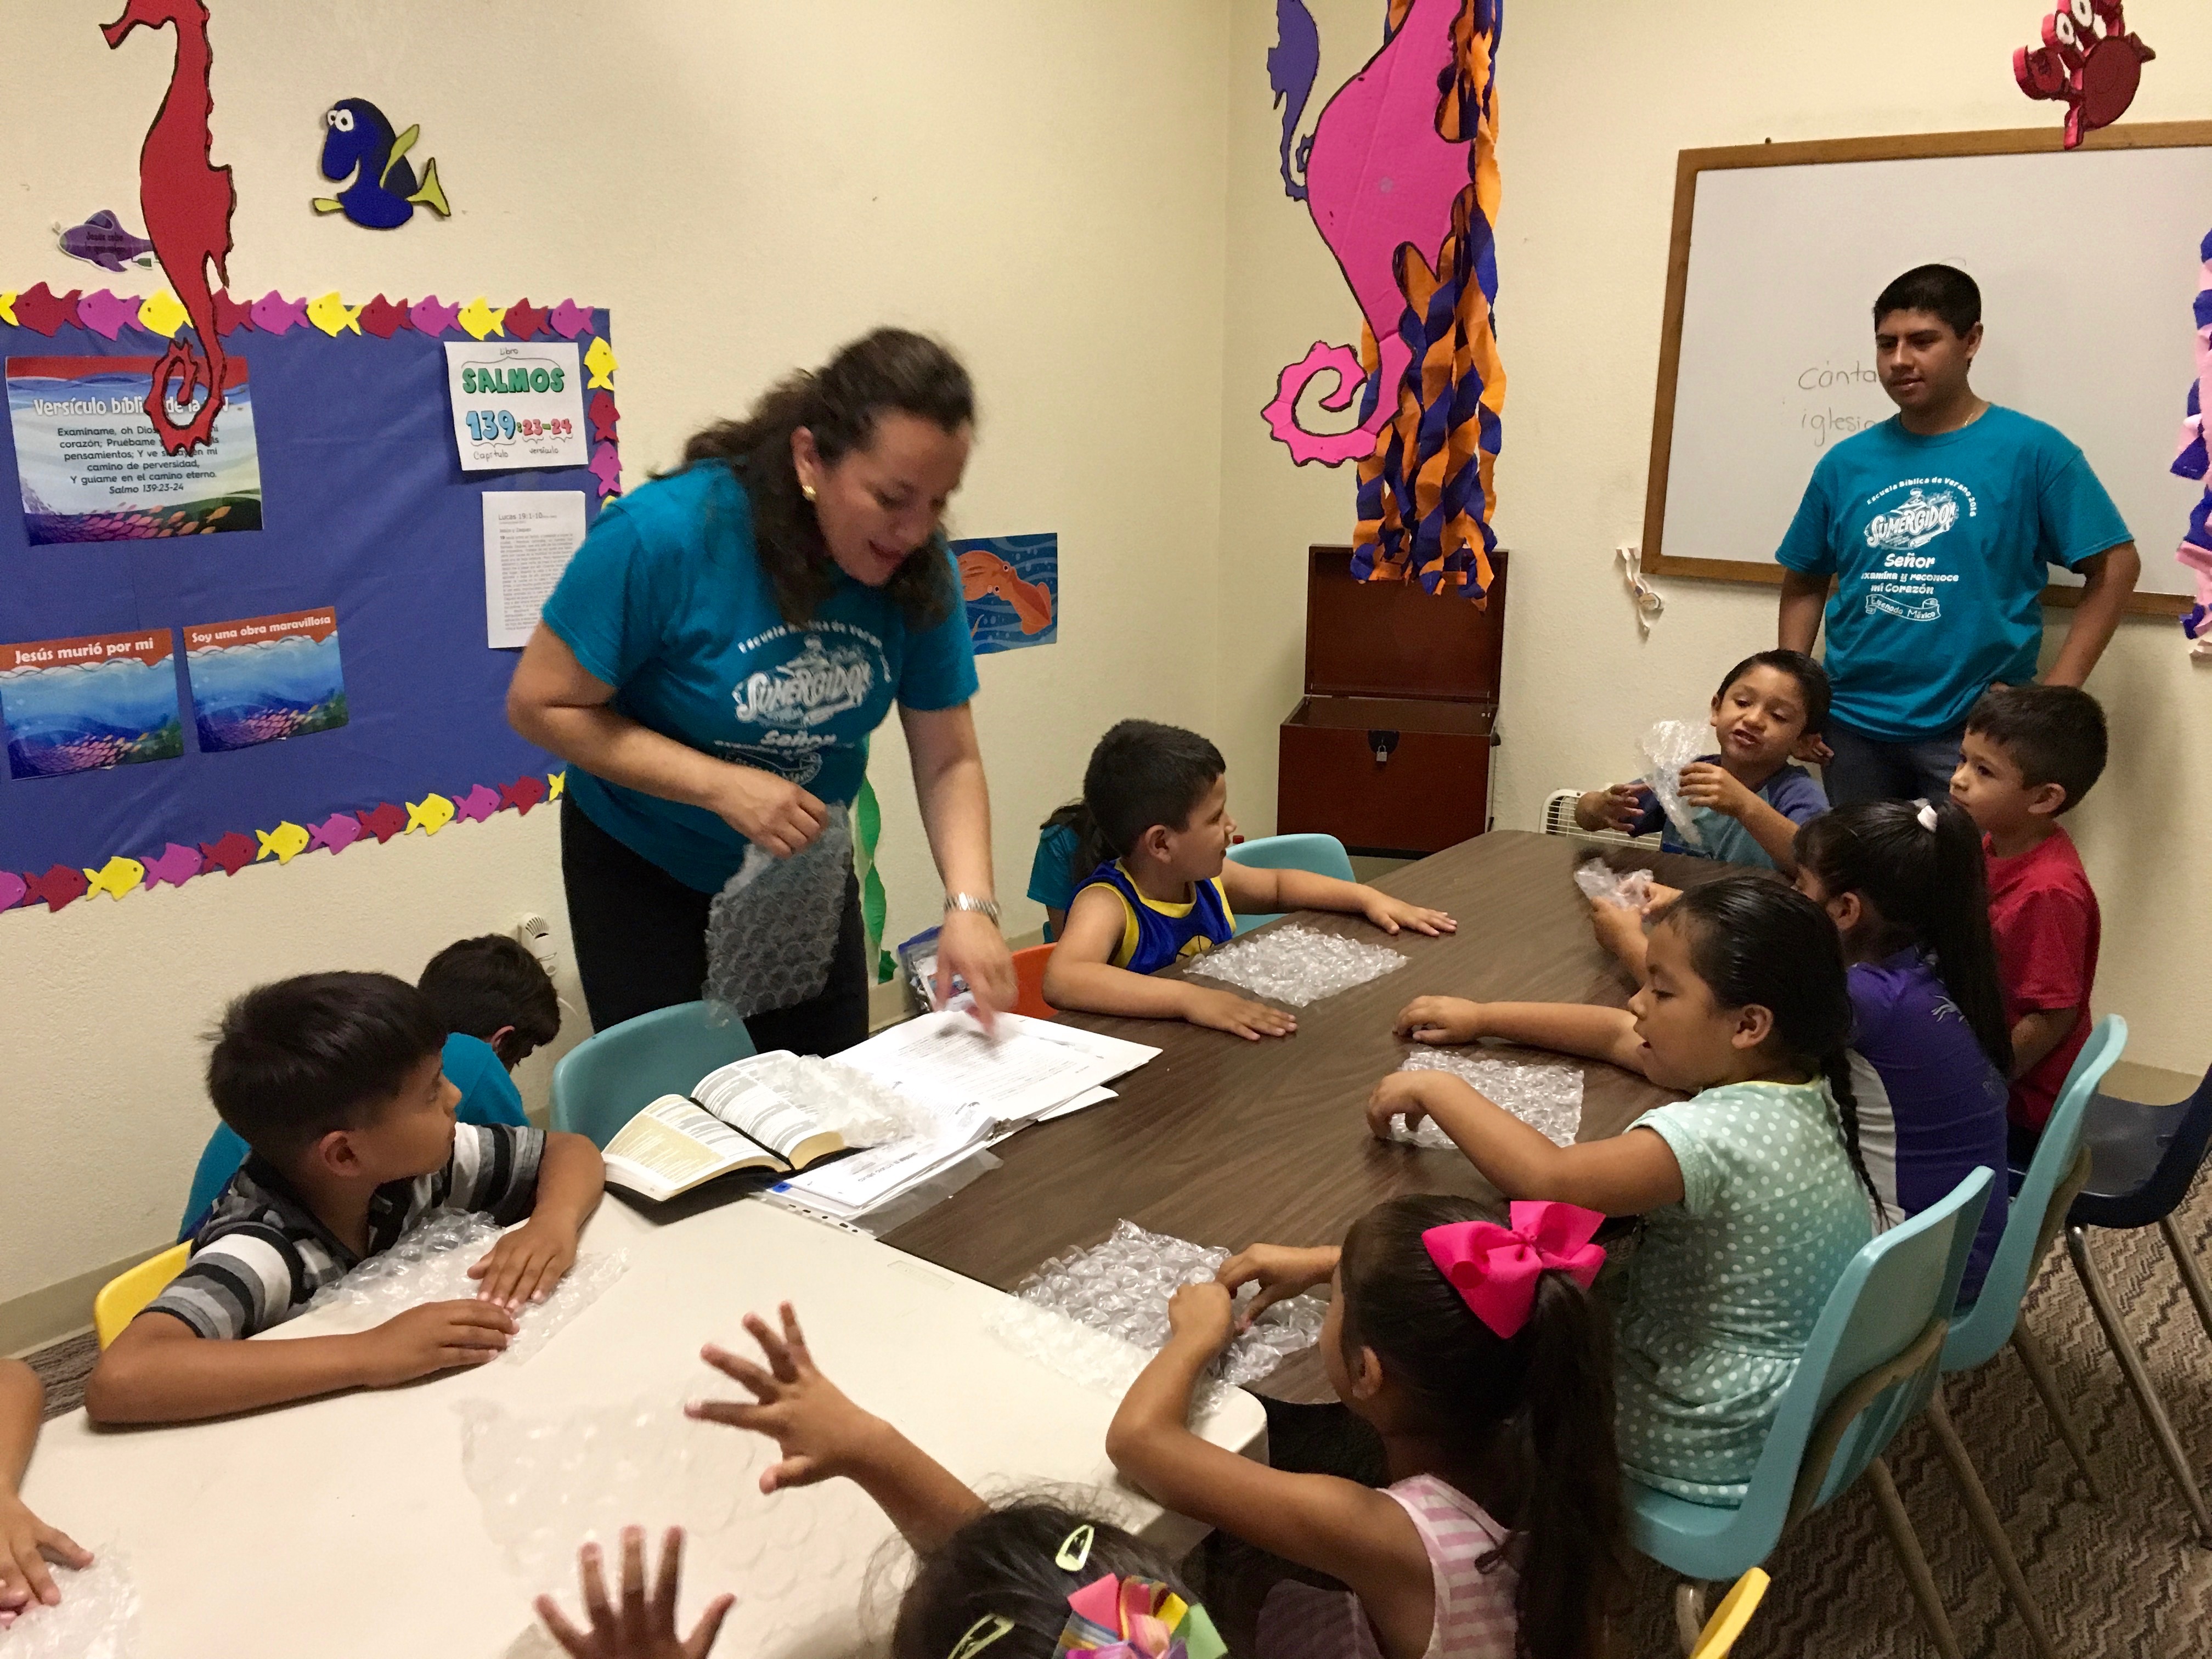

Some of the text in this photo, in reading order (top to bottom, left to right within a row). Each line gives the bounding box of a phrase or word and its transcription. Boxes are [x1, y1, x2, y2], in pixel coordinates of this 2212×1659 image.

[462, 367, 565, 393] SALMOS
[33, 396, 107, 416] Versículo
[111, 396, 144, 414] bíbli
[166, 396, 184, 413] de
[121, 426, 133, 435] oh
[466, 410, 573, 441] 139:23-24
[60, 439, 103, 448] corazón;
[106, 438, 156, 447] Pruébame
[64, 450, 134, 462] pensamientos;
[87, 462, 123, 471] camino
[127, 461, 139, 470] de
[70, 476, 77, 484] Y
[149, 472, 183, 481] camino
[109, 483, 184, 494] Salmo 139:23-24
[1867, 484, 1897, 505] Escuela
[1944, 477, 1971, 497] Verano
[1968, 498, 1977, 517] 2016
[1884, 552, 1936, 568] Señor
[1899, 573, 1908, 583] y
[1910, 572, 1960, 582] reconoce
[1885, 583, 1934, 595] Corazón
[191, 616, 331, 643] Soy una obra maravillosa
[15, 648, 54, 664] Jesús
[57, 642, 103, 659] murió
[106, 642, 131, 656] por
